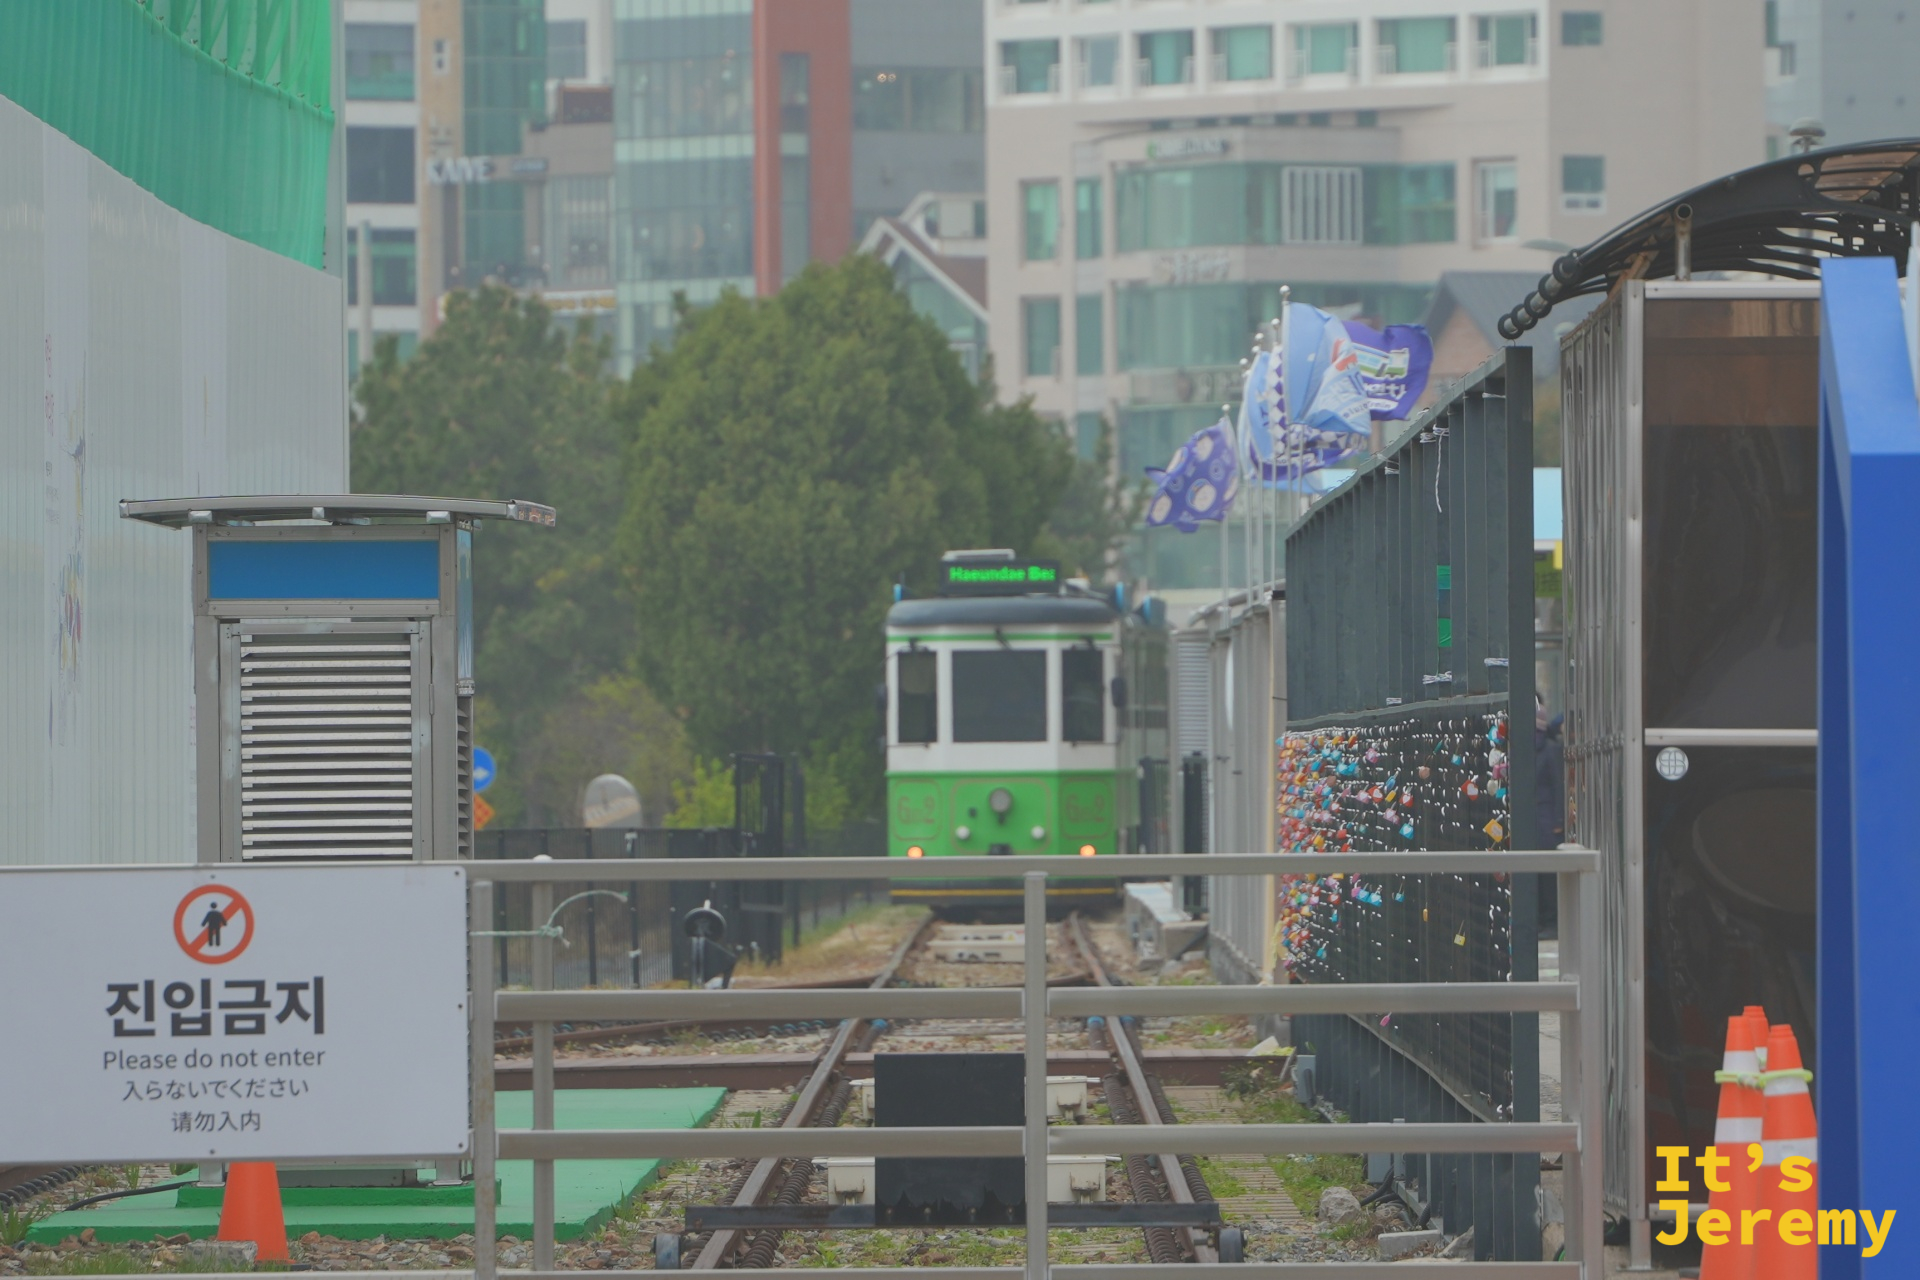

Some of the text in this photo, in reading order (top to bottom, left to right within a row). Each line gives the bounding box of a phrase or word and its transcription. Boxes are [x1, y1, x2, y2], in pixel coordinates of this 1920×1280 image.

[949, 566, 1026, 581] Haeundae
[105, 976, 324, 1038] 진입금지
[104, 1048, 325, 1070] Please do not enter
[123, 1078, 308, 1101] 入らないでください
[172, 1110, 260, 1132] 请勿入内
